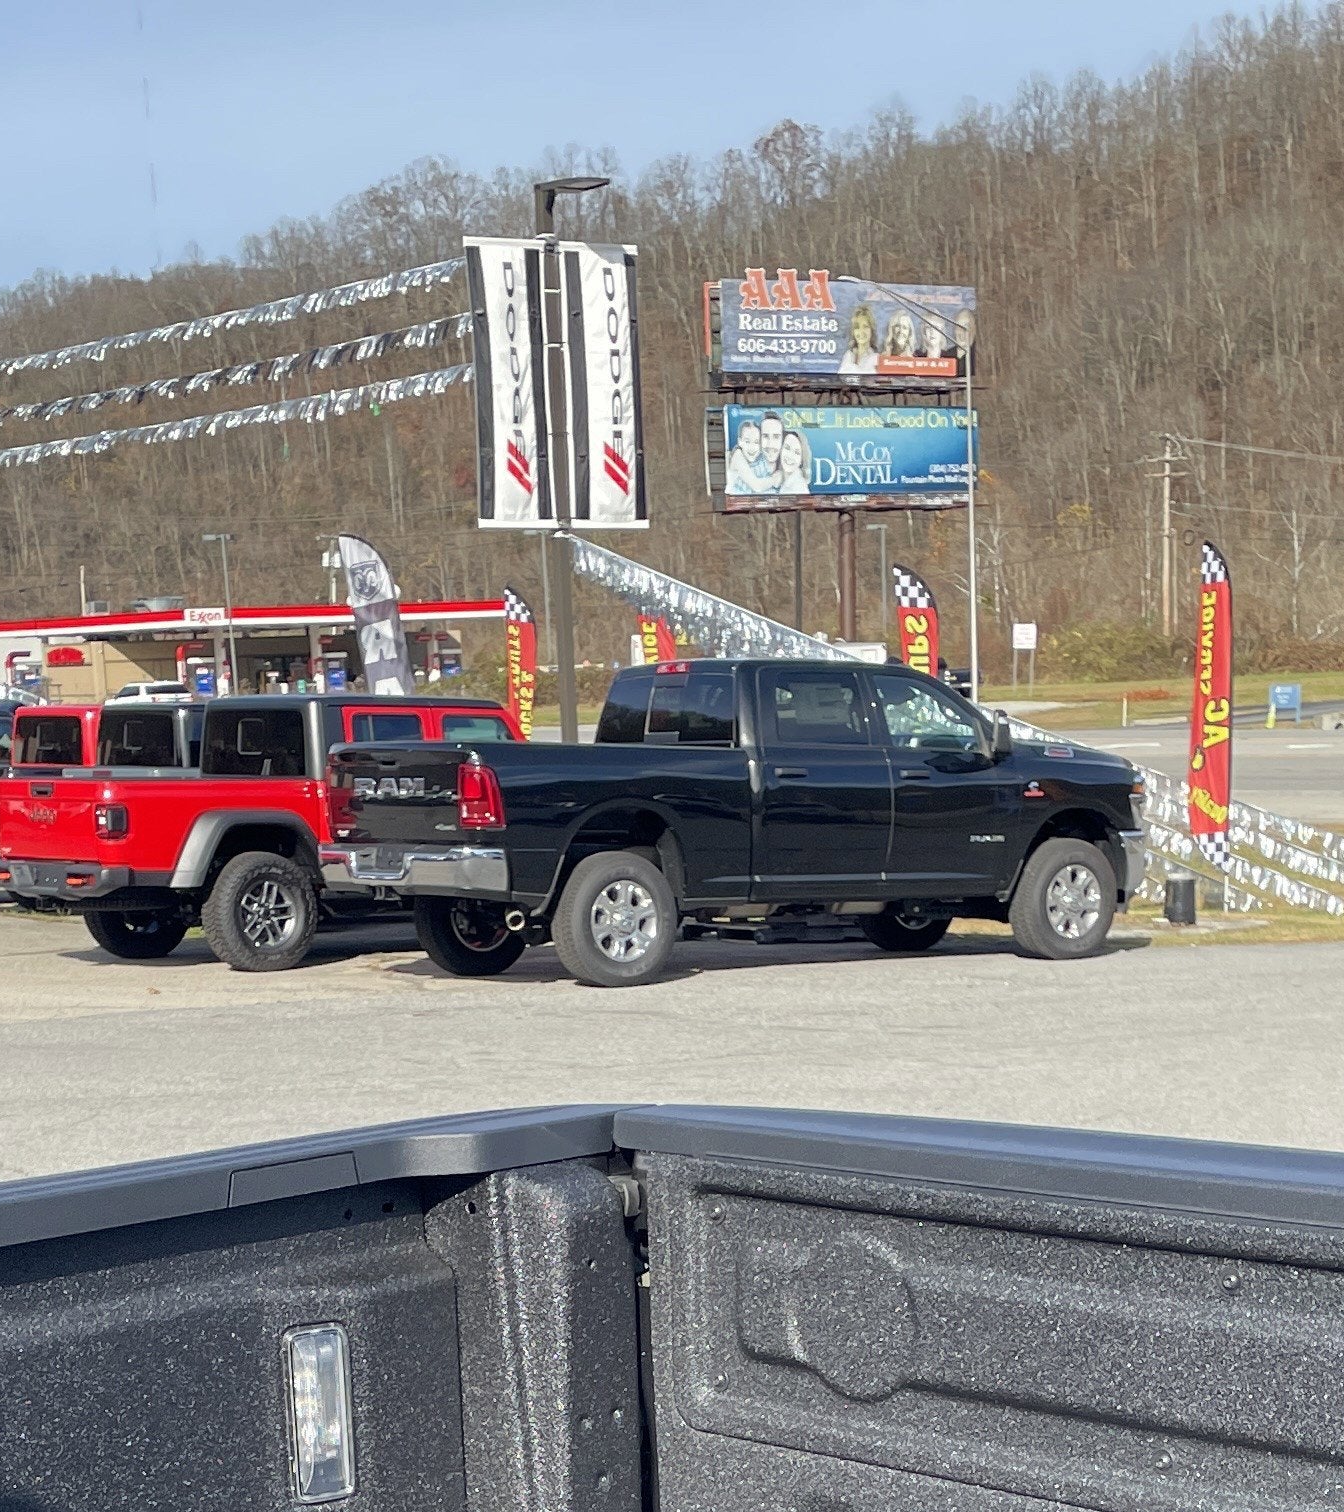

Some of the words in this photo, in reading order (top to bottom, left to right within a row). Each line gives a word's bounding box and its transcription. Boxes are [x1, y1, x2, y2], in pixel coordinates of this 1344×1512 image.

[738, 267, 836, 312] AAA
[738, 313, 777, 331] Real
[780, 314, 839, 332] Estate
[737, 338, 837, 354] 606-433-9700
[503, 262, 527, 463] DODGE
[602, 267, 624, 464] DODGE
[886, 411, 924, 429] Good
[927, 411, 949, 429] On
[813, 457, 899, 486] DENTAL
[189, 609, 222, 624] Exxon
[353, 777, 426, 799] RAM
